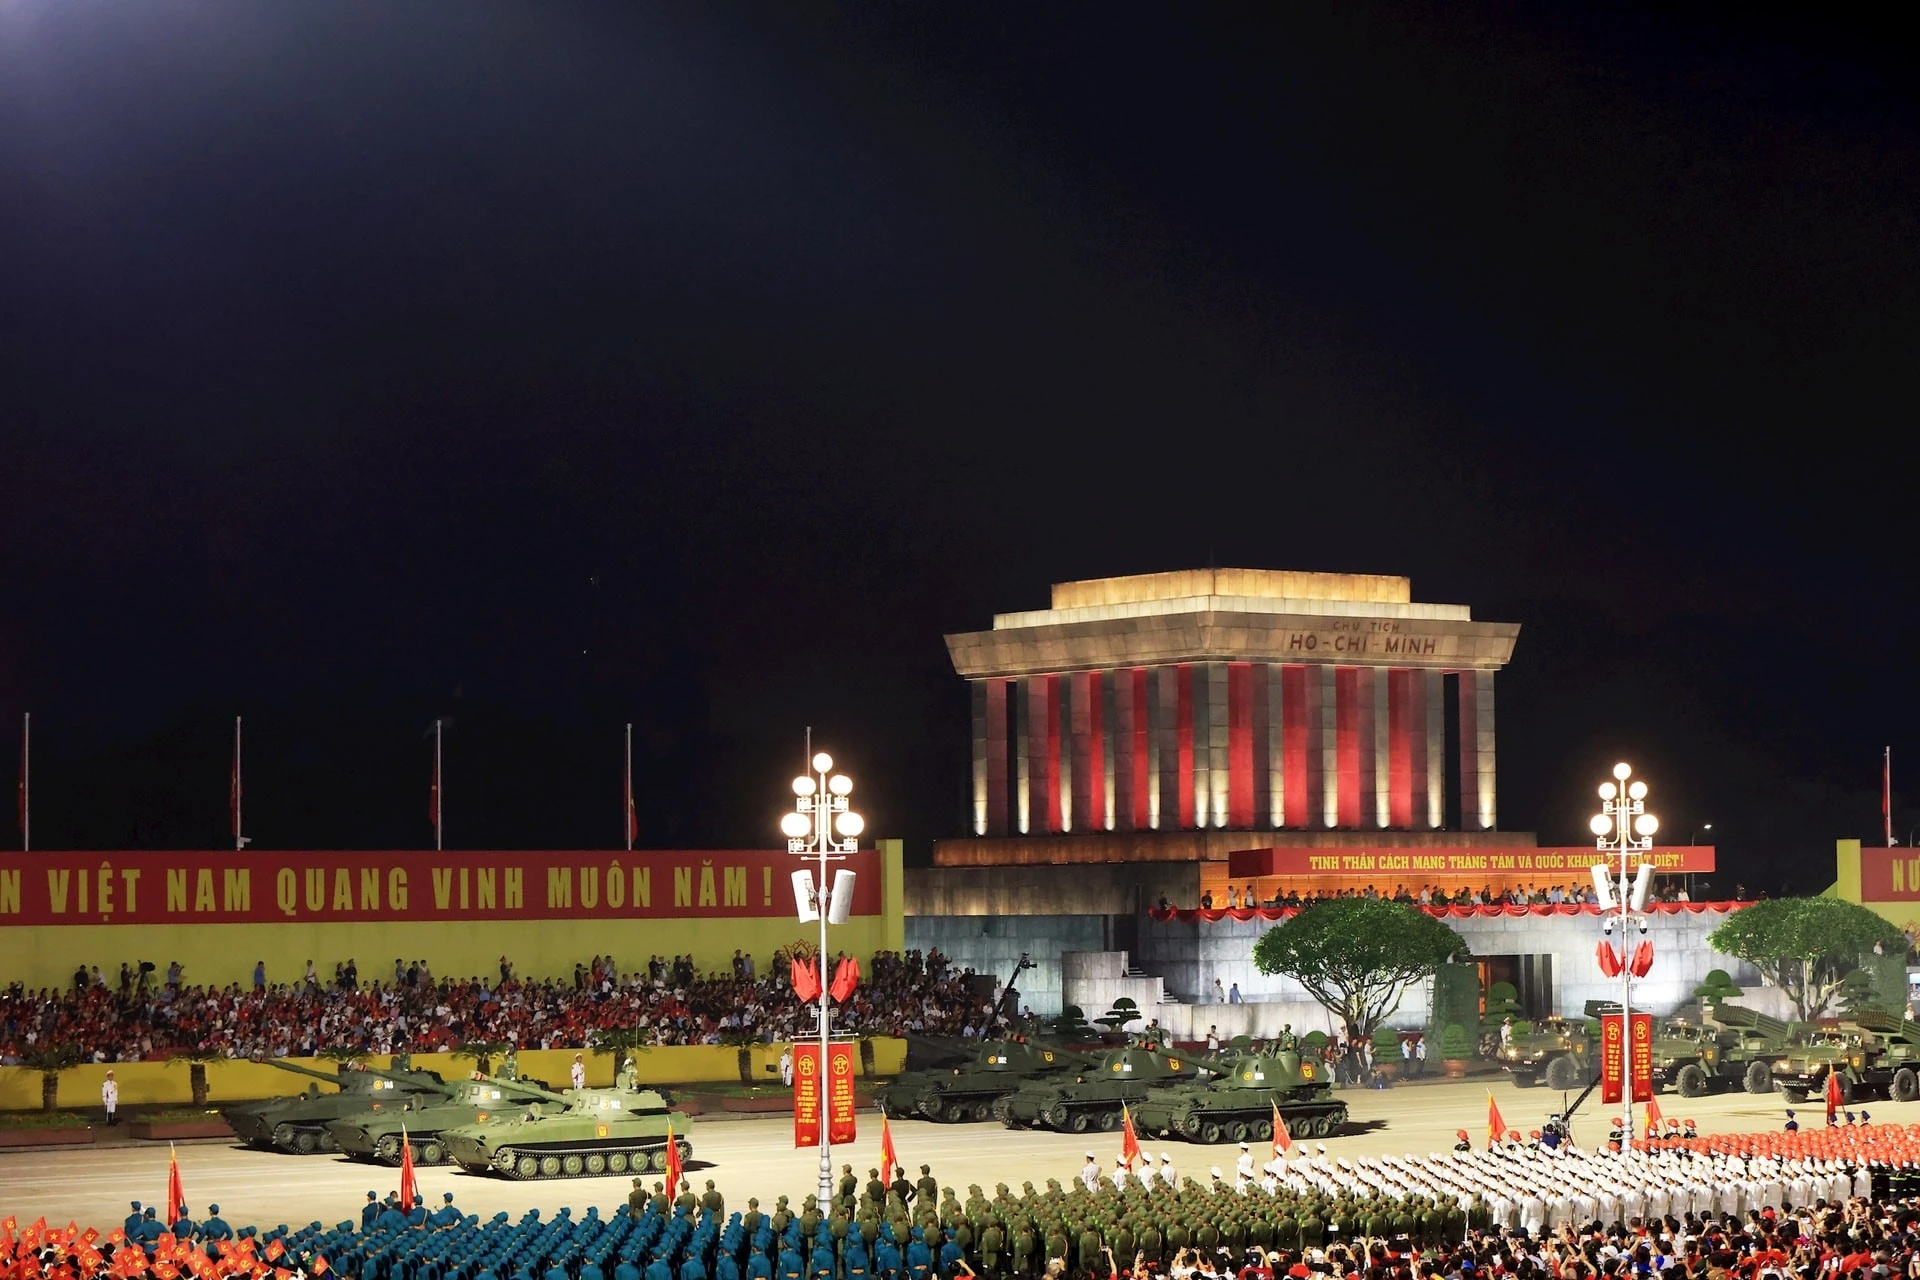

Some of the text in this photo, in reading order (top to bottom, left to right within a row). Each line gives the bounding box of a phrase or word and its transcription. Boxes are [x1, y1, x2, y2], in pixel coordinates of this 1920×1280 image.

[1309, 855, 1340, 870] TINH
[1378, 853, 1410, 870] CÁCH
[1412, 855, 1446, 872] MẠNG
[1448, 853, 1487, 870] THÁNG
[1490, 853, 1515, 869] TÁM
[1518, 853, 1533, 869] VÀ
[1535, 851, 1564, 870] QUỐC
[1567, 853, 1604, 868] KHÁNH
[48, 861, 141, 921] VIỆT
[167, 868, 251, 913] NAM
[277, 867, 409, 916] QUANG
[431, 867, 524, 910] VINH
[547, 859, 651, 909] MUÔN
